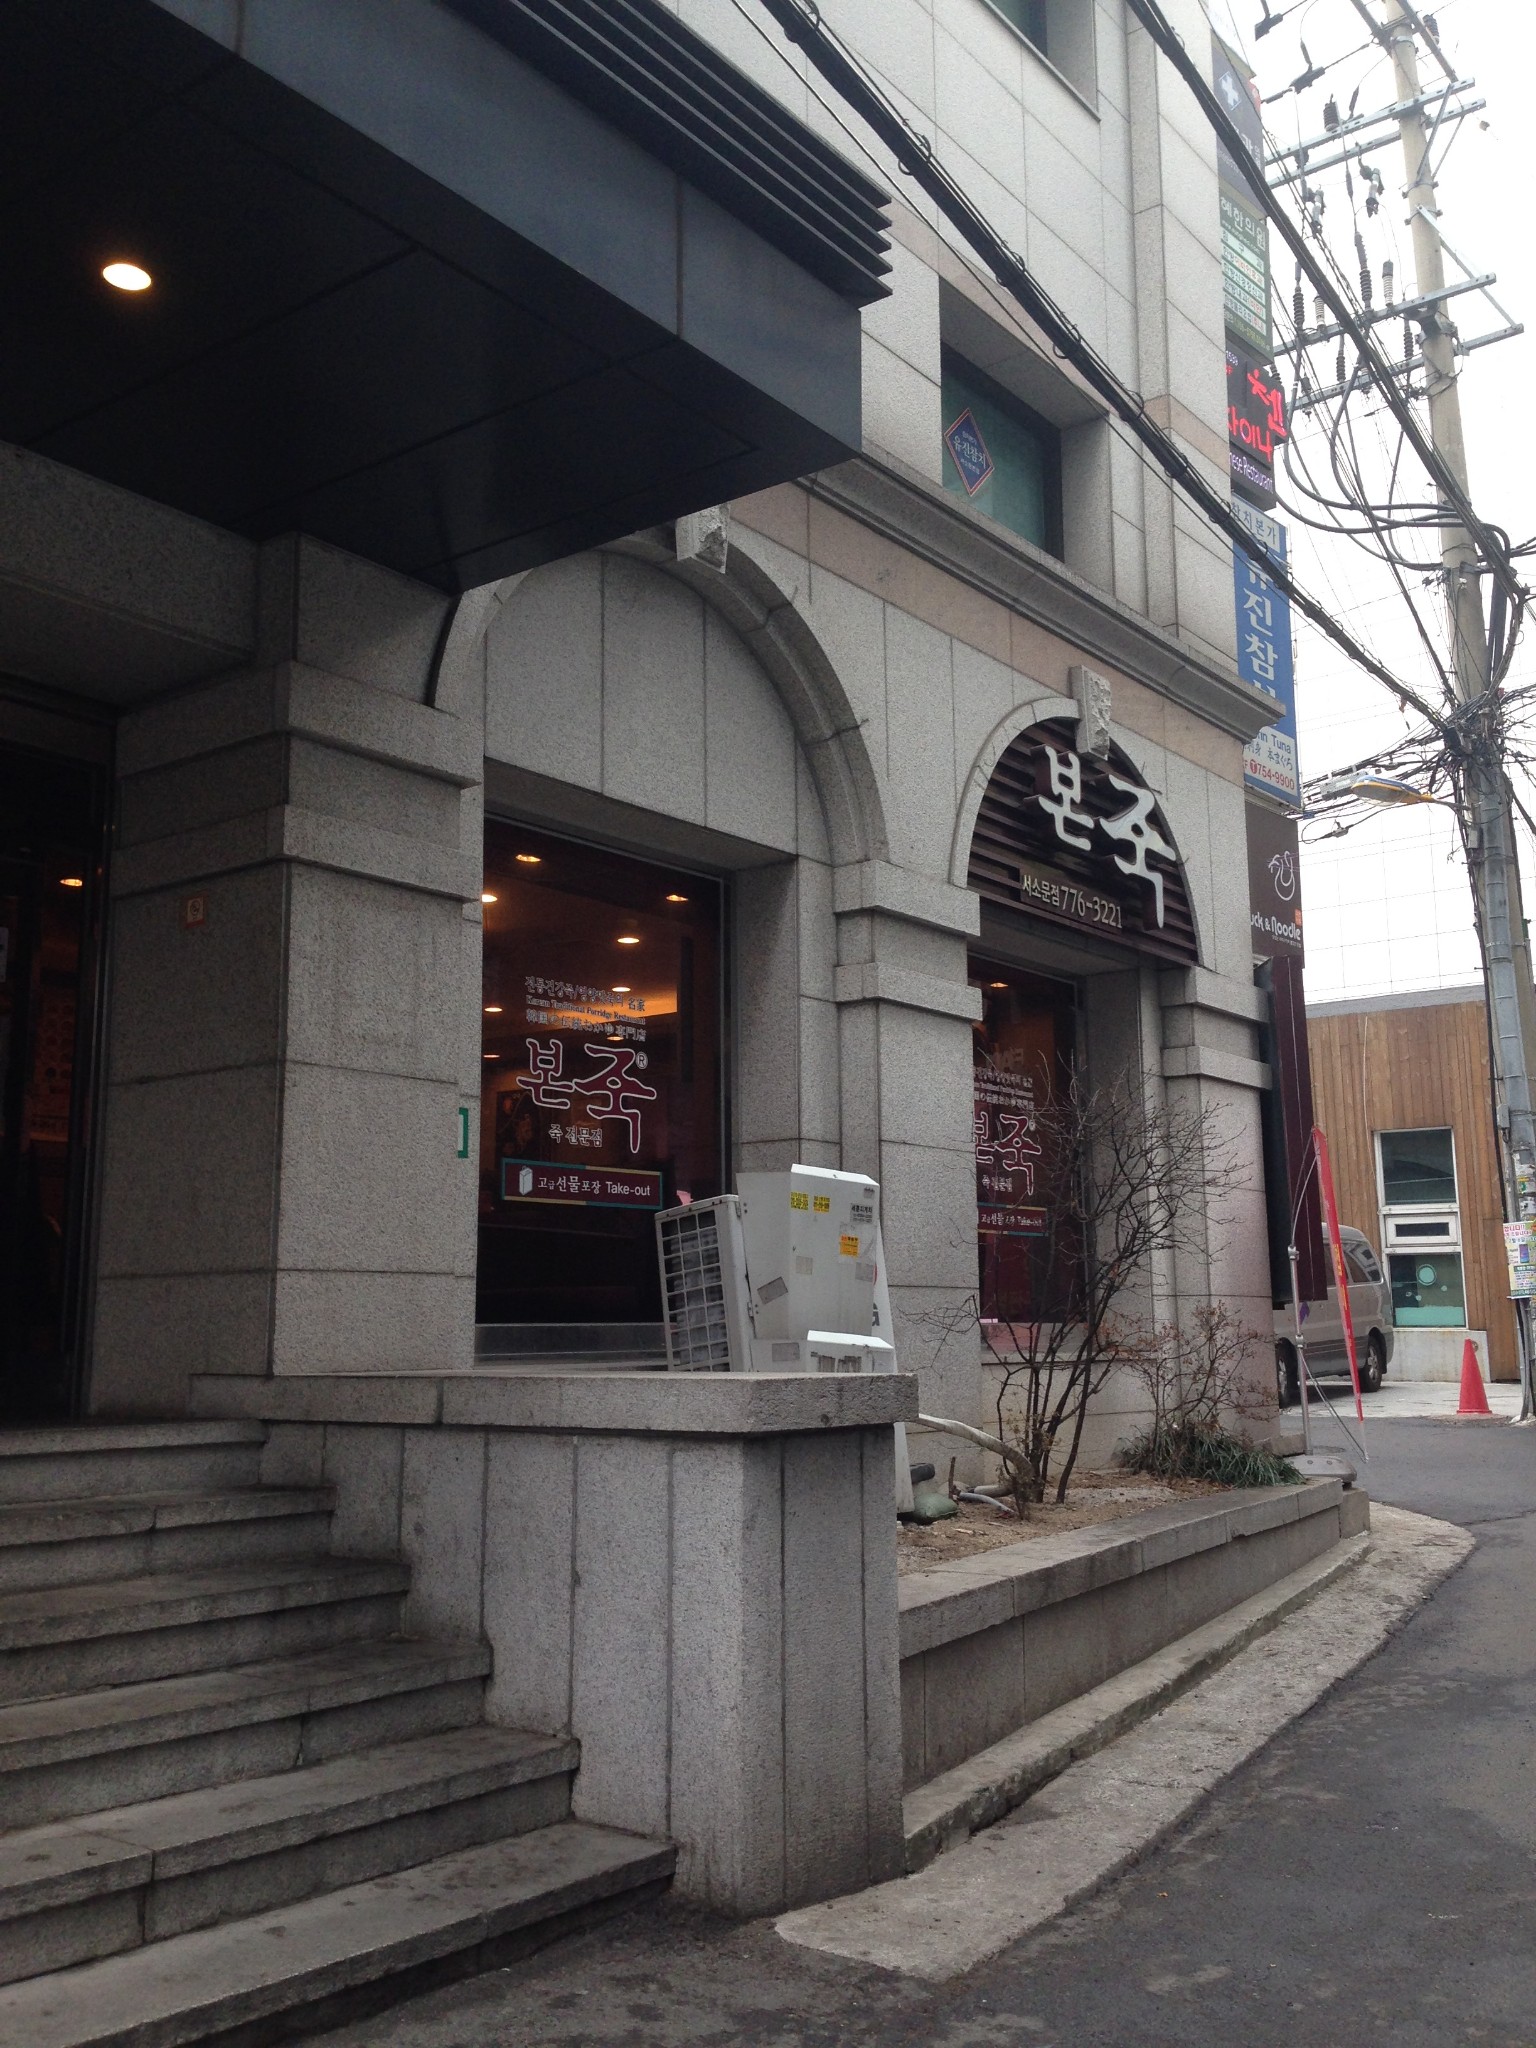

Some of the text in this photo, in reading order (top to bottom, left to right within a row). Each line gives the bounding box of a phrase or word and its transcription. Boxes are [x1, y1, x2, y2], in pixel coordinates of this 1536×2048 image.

[1271, 734, 1291, 754] Tuna
[1038, 745, 1176, 929] 본죽
[1023, 875, 1122, 929] 서소문점 776-3221
[586, 1007, 612, 1019] Porridge
[516, 1038, 657, 1154] 본죽
[548, 1124, 603, 1147] 죽 전문점
[606, 1181, 651, 1196] Take-out
